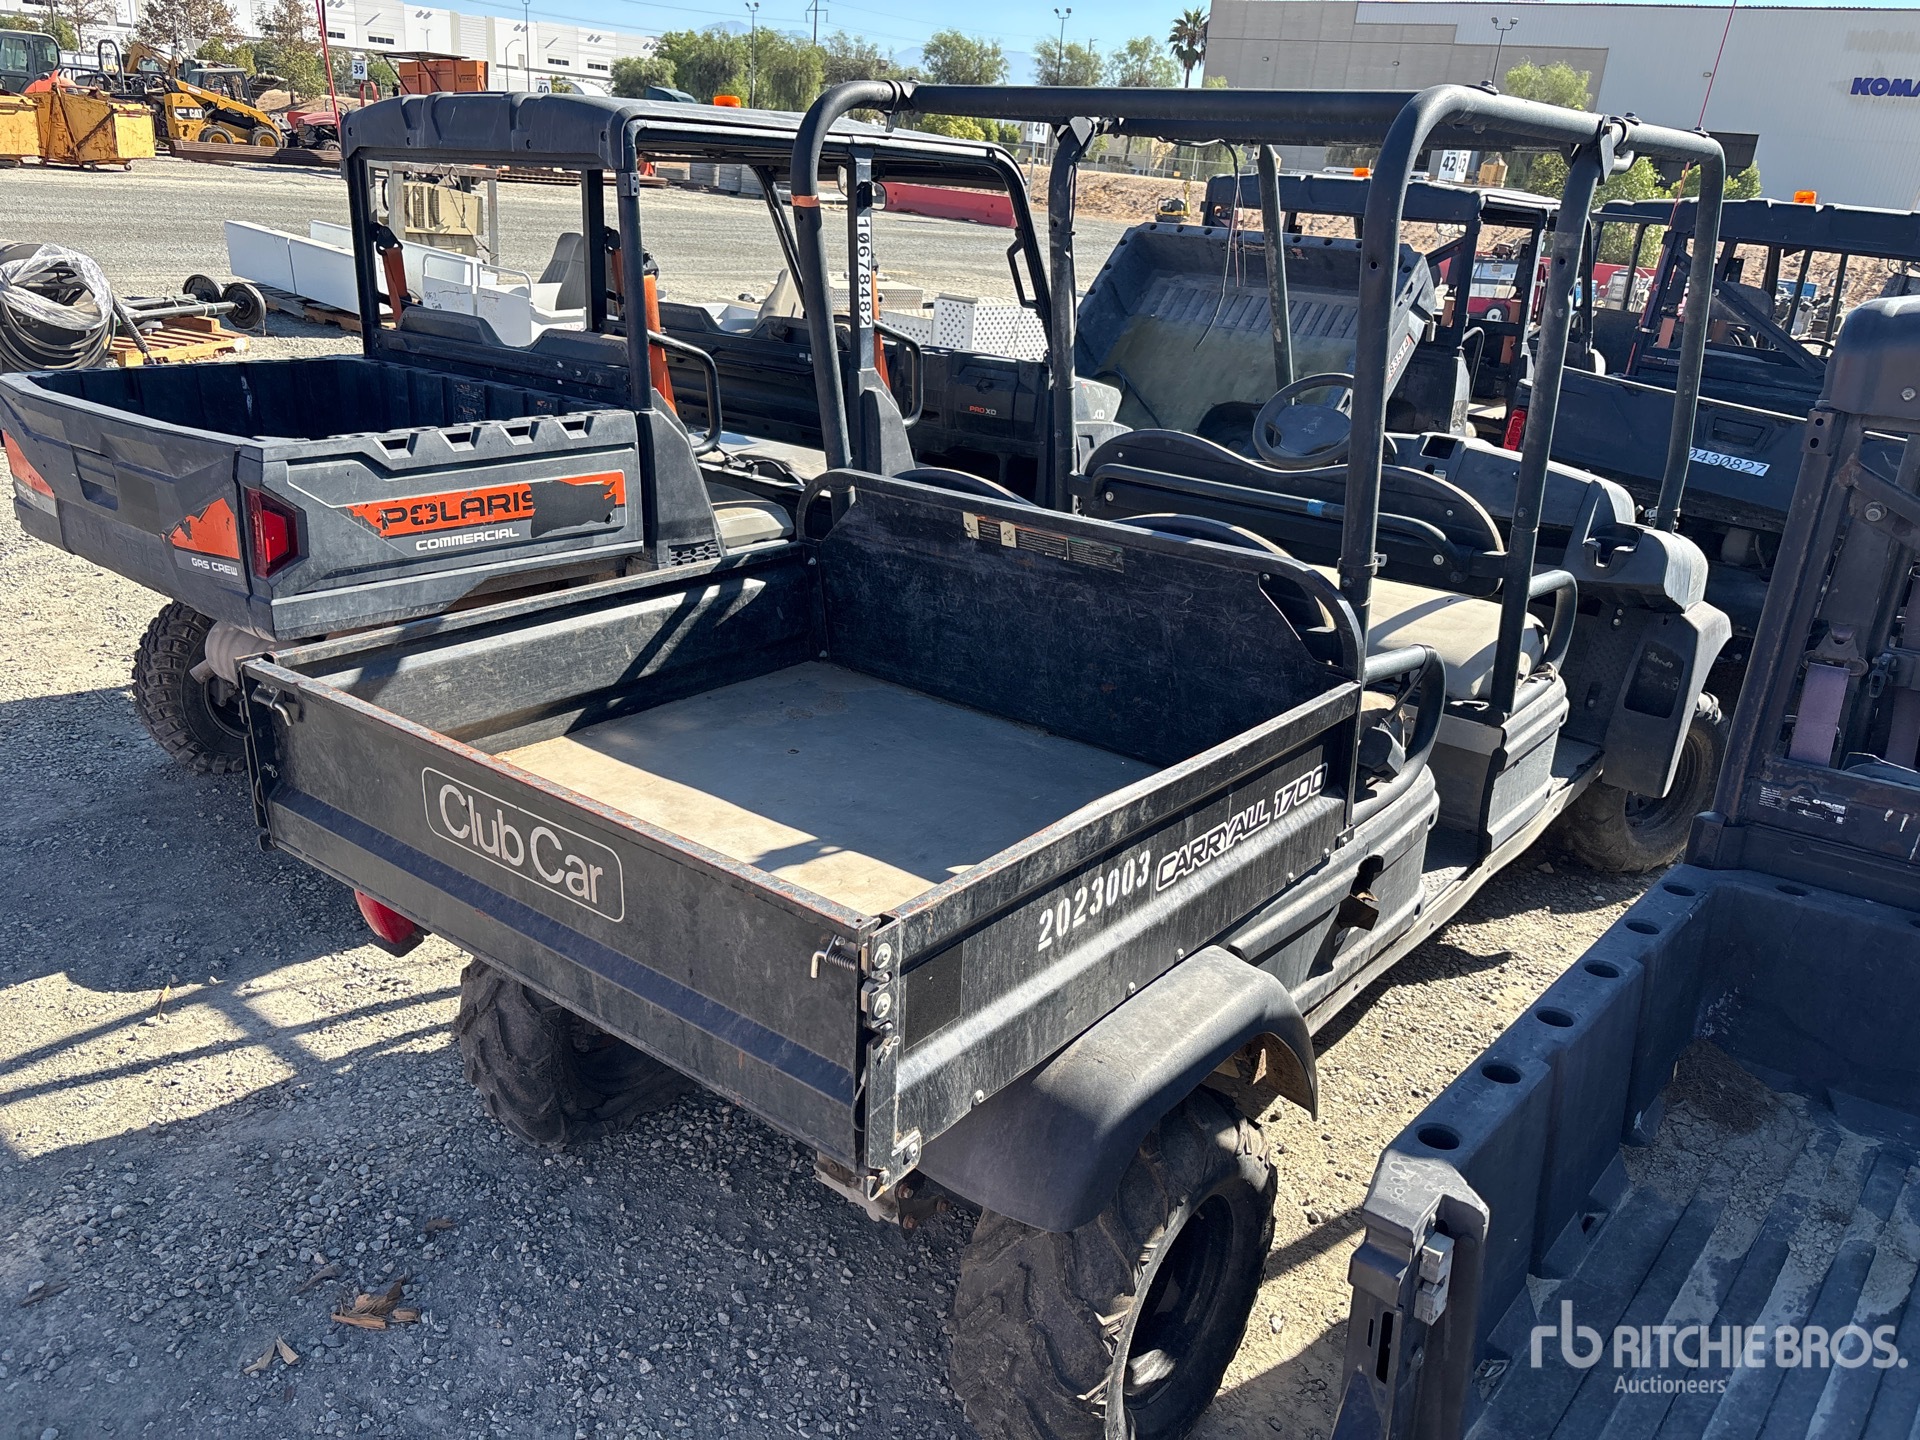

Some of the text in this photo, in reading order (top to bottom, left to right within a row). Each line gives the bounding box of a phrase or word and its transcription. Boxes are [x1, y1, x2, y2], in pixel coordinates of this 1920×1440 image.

[353, 64, 364, 75] 39
[189, 108, 203, 119] CAT
[1034, 122, 1046, 135] 41
[1442, 156, 1456, 171] 42
[857, 218, 872, 327] 10678482
[969, 405, 997, 416] PRO XD
[415, 528, 519, 551] COMMERCIAL
[191, 557, 238, 576] GAS CREW
[1156, 762, 1328, 891] CARRYALL 1700
[439, 784, 604, 904] Club Car
[1038, 850, 1151, 952] 2023003
